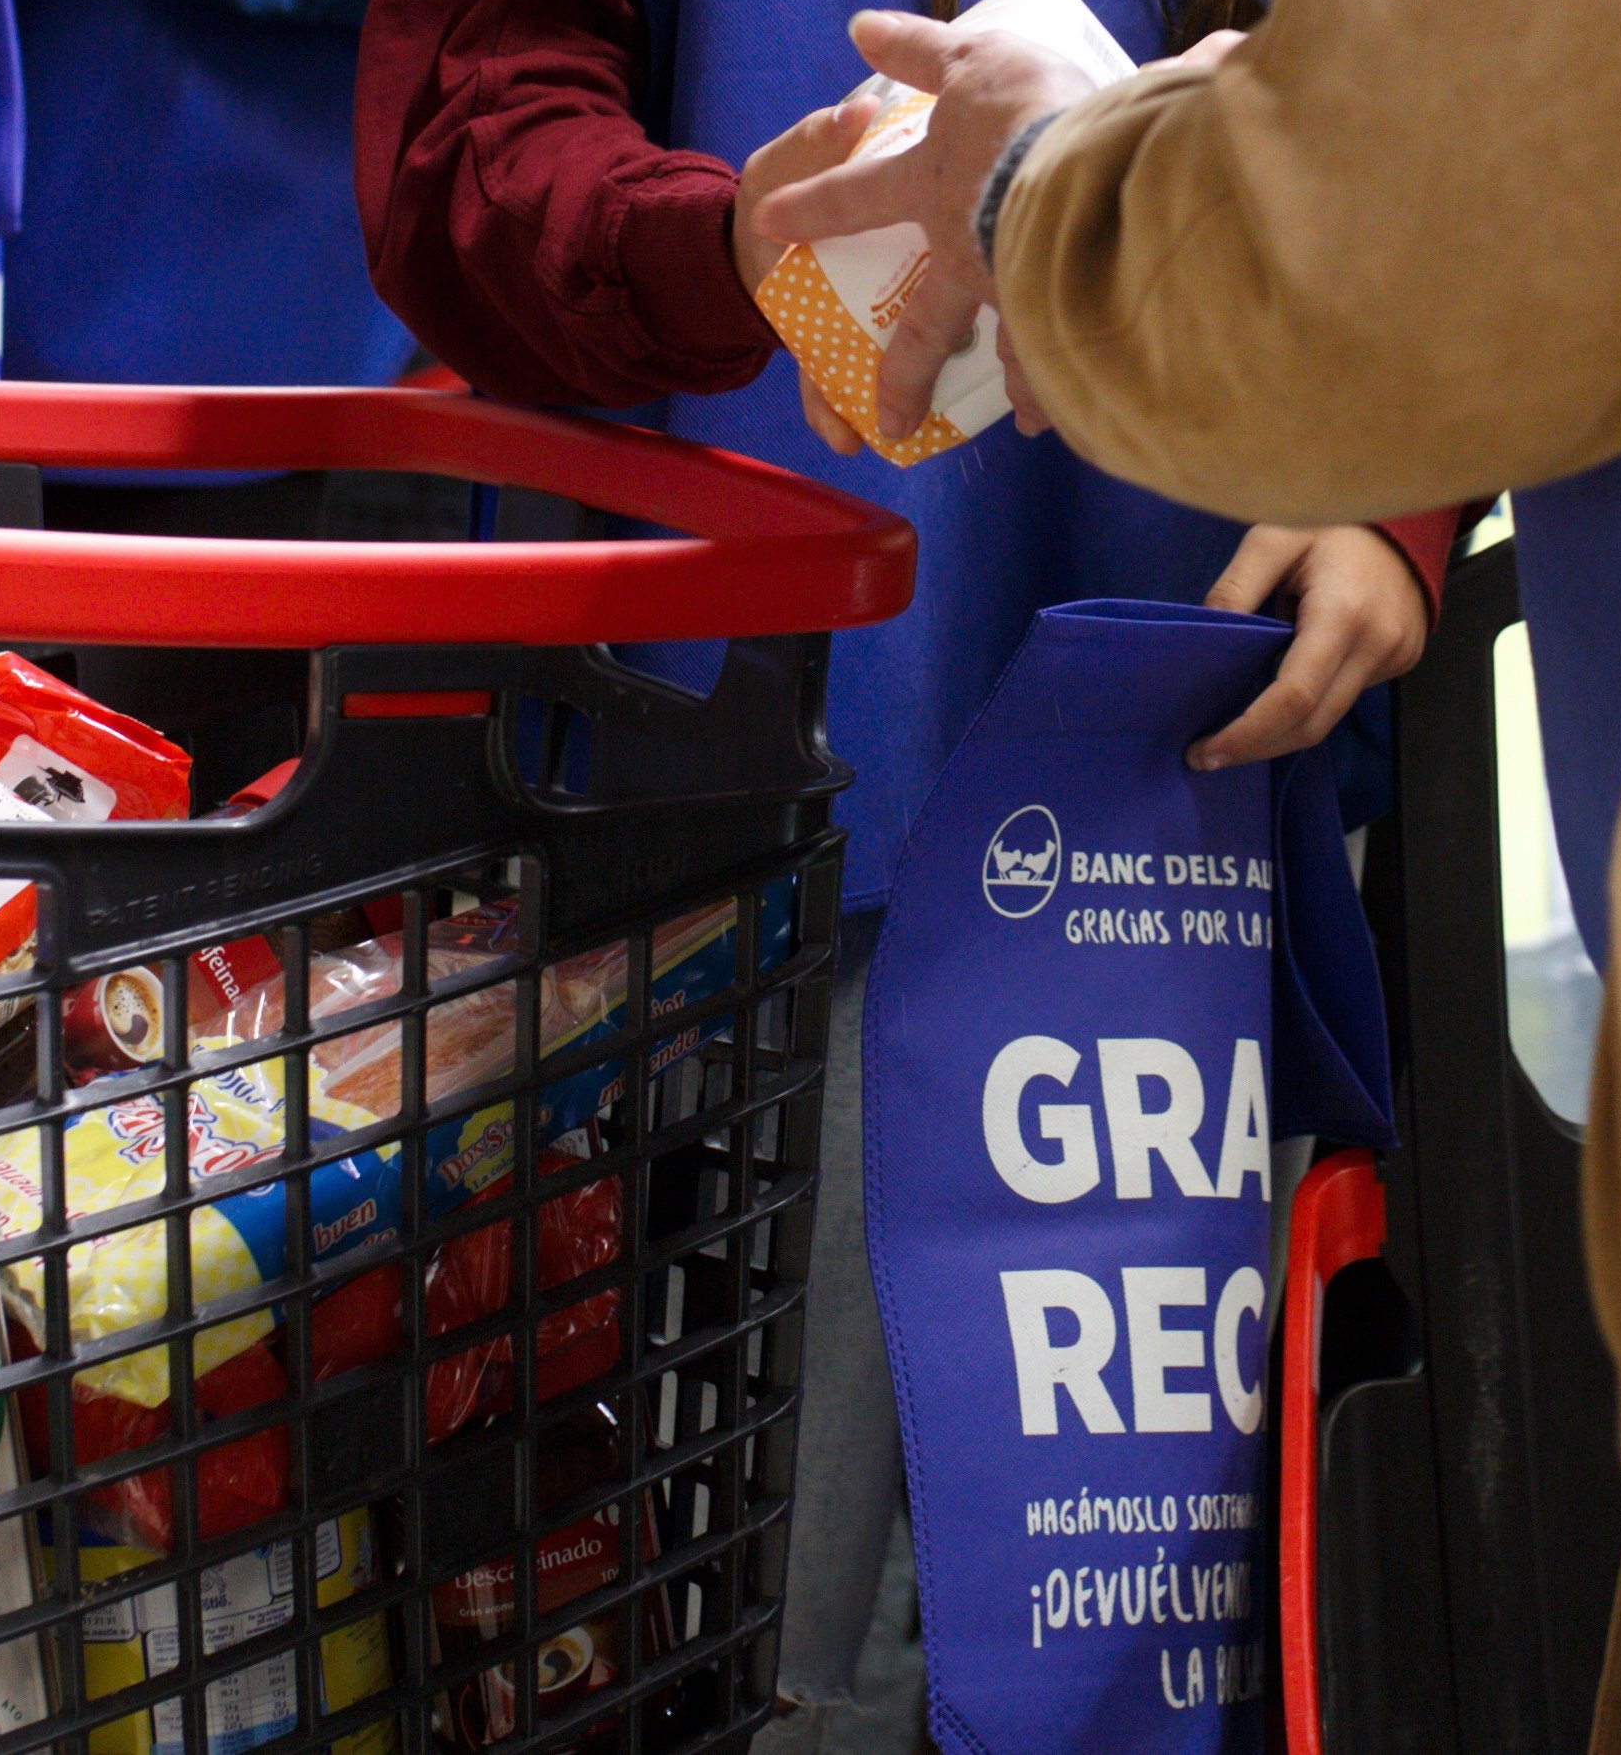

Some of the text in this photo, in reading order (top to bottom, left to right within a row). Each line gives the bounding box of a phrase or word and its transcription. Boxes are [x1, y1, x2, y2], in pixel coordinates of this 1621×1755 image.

[1070, 851, 1155, 885] BANC
[1163, 854, 1238, 886] DELS
[1181, 909, 1230, 945] POR
[1237, 911, 1263, 947] LA
[313, 1197, 376, 1252] buen
[1026, 1486, 1177, 1536] HAGÁMOSLO
[1160, 1647, 1205, 1710] LA
